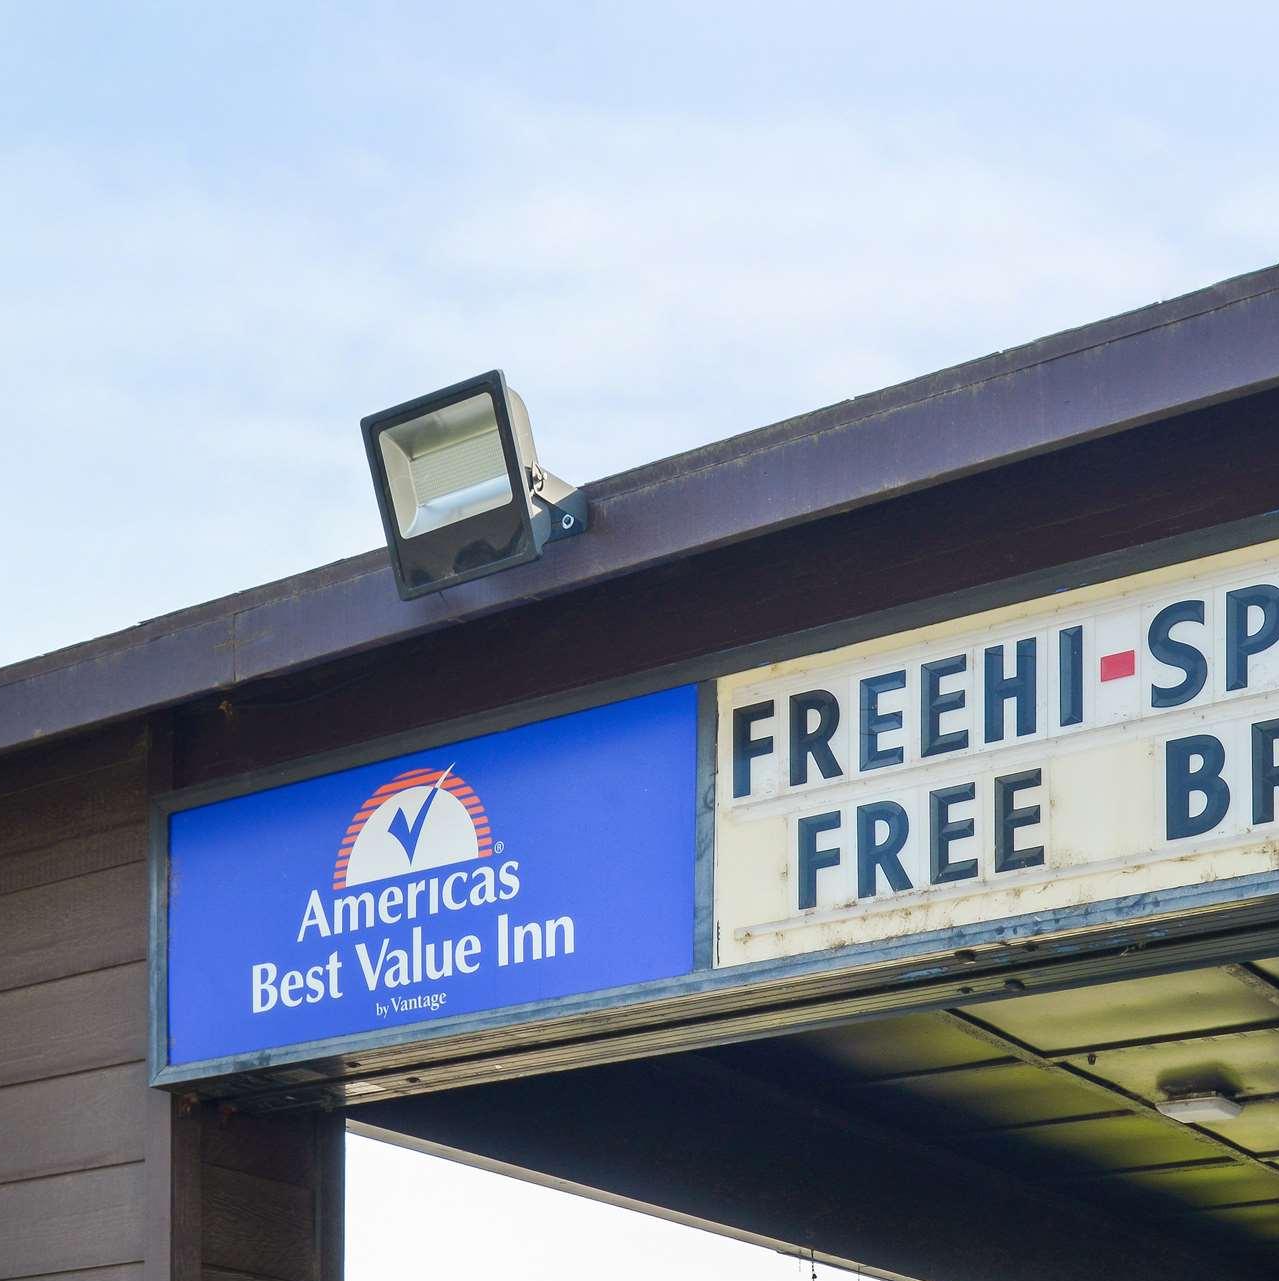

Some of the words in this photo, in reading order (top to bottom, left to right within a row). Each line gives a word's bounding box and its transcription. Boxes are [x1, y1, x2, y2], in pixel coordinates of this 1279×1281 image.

[797, 767, 1046, 910] FREE
[296, 860, 521, 943] Americas
[252, 949, 344, 1014] Best
[355, 926, 482, 991] Value
[497, 912, 576, 967] Inn
[376, 1002, 390, 1018] by
[390, 990, 448, 1013] Vantage
